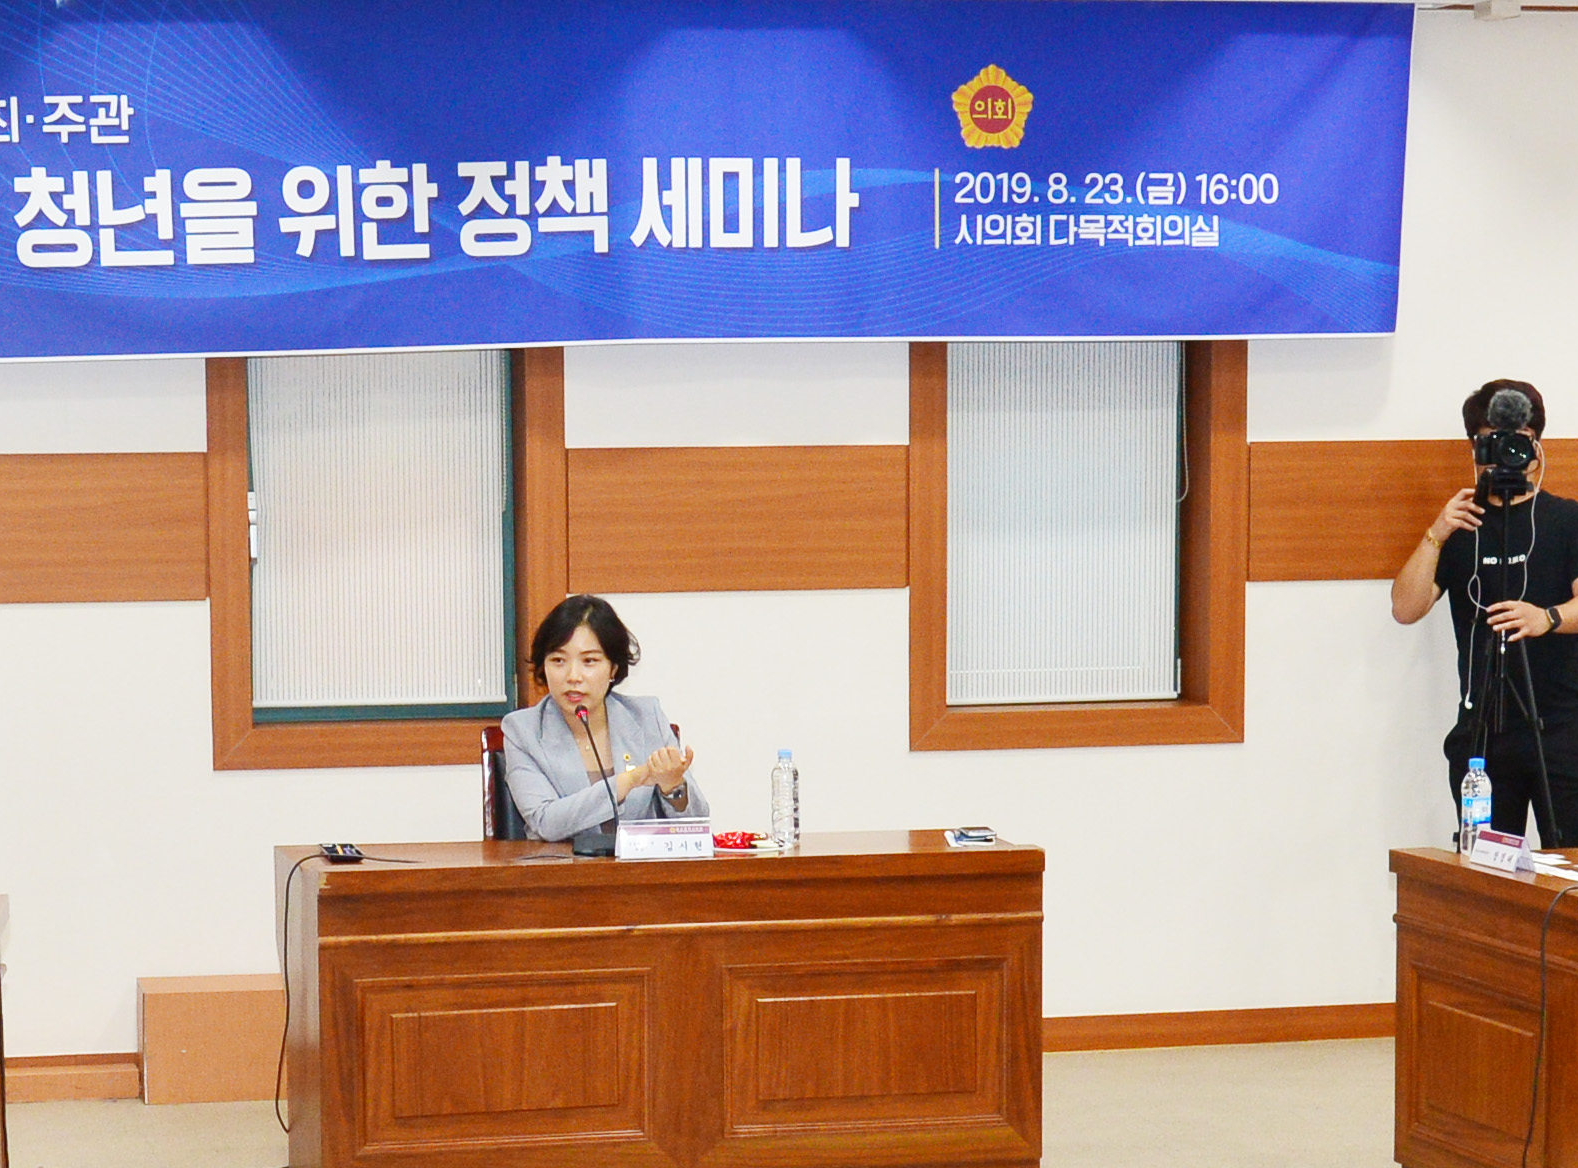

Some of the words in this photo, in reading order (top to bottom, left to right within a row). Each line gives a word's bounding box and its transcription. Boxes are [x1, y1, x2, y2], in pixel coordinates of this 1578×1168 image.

[972, 97, 1012, 119] 의회
[954, 171, 1039, 204] 2019.
[1047, 172, 1076, 205] 8.
[1195, 172, 1279, 205] 16:00
[13, 166, 258, 268] 청년을
[278, 159, 438, 261] 위한
[457, 155, 609, 257] 정책
[629, 156, 860, 249] 세미나
[954, 213, 1042, 246] 시의회
[1049, 213, 1220, 248] 다목적회의실
